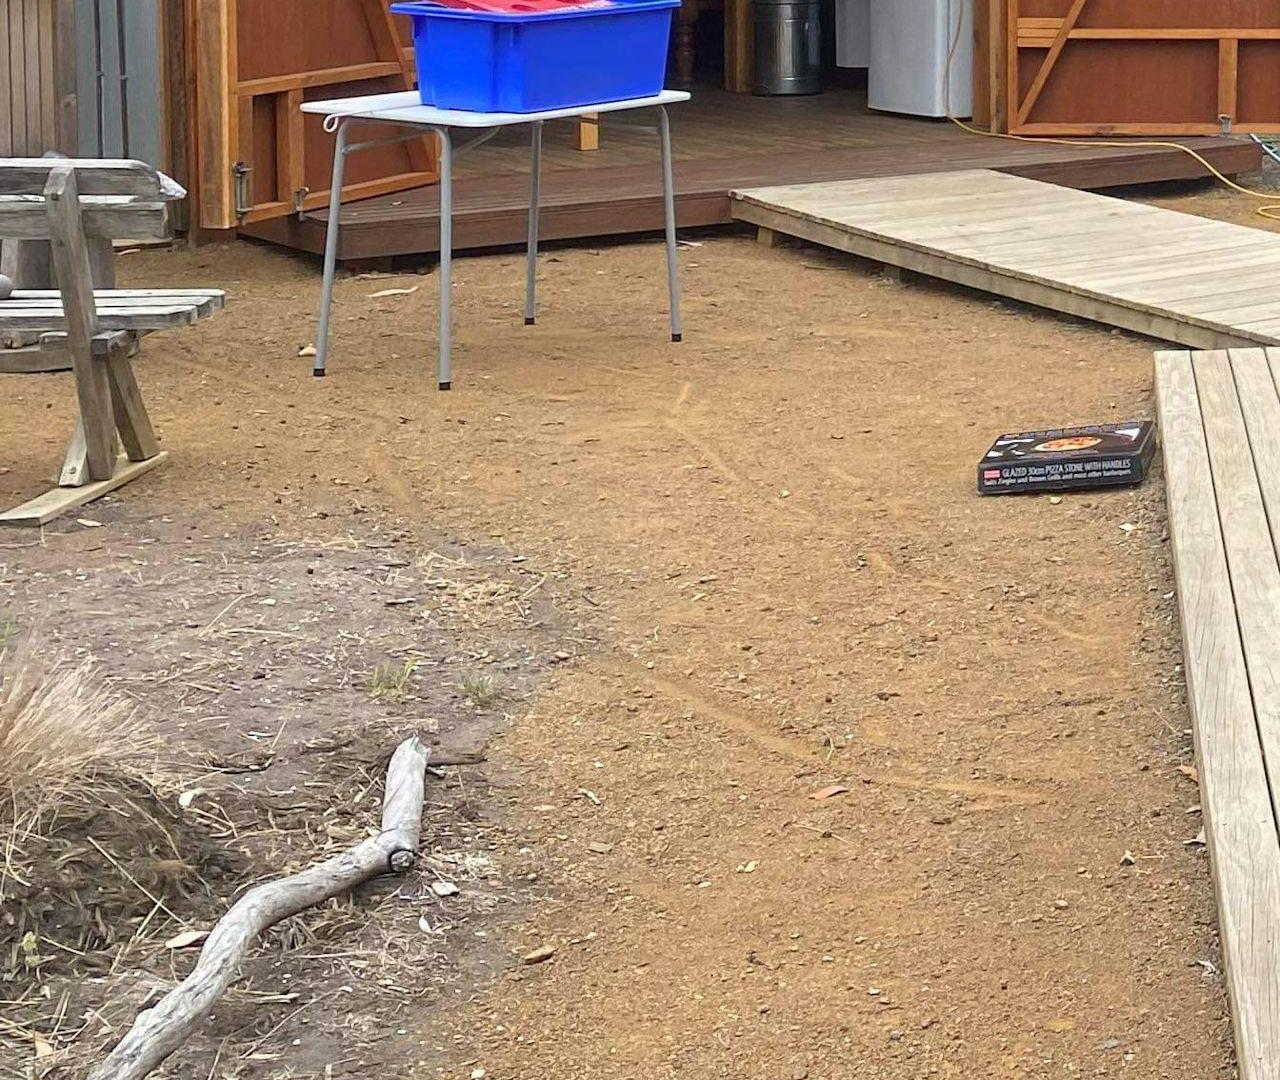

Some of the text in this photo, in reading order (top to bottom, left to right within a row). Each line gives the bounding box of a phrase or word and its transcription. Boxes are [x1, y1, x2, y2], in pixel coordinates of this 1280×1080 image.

[1002, 466, 1027, 478] GLAZED
[1045, 464, 1064, 474] PIZZA
[1064, 462, 1084, 473] STONE
[1084, 461, 1101, 472] WITH
[1102, 458, 1131, 470] HANDLES
